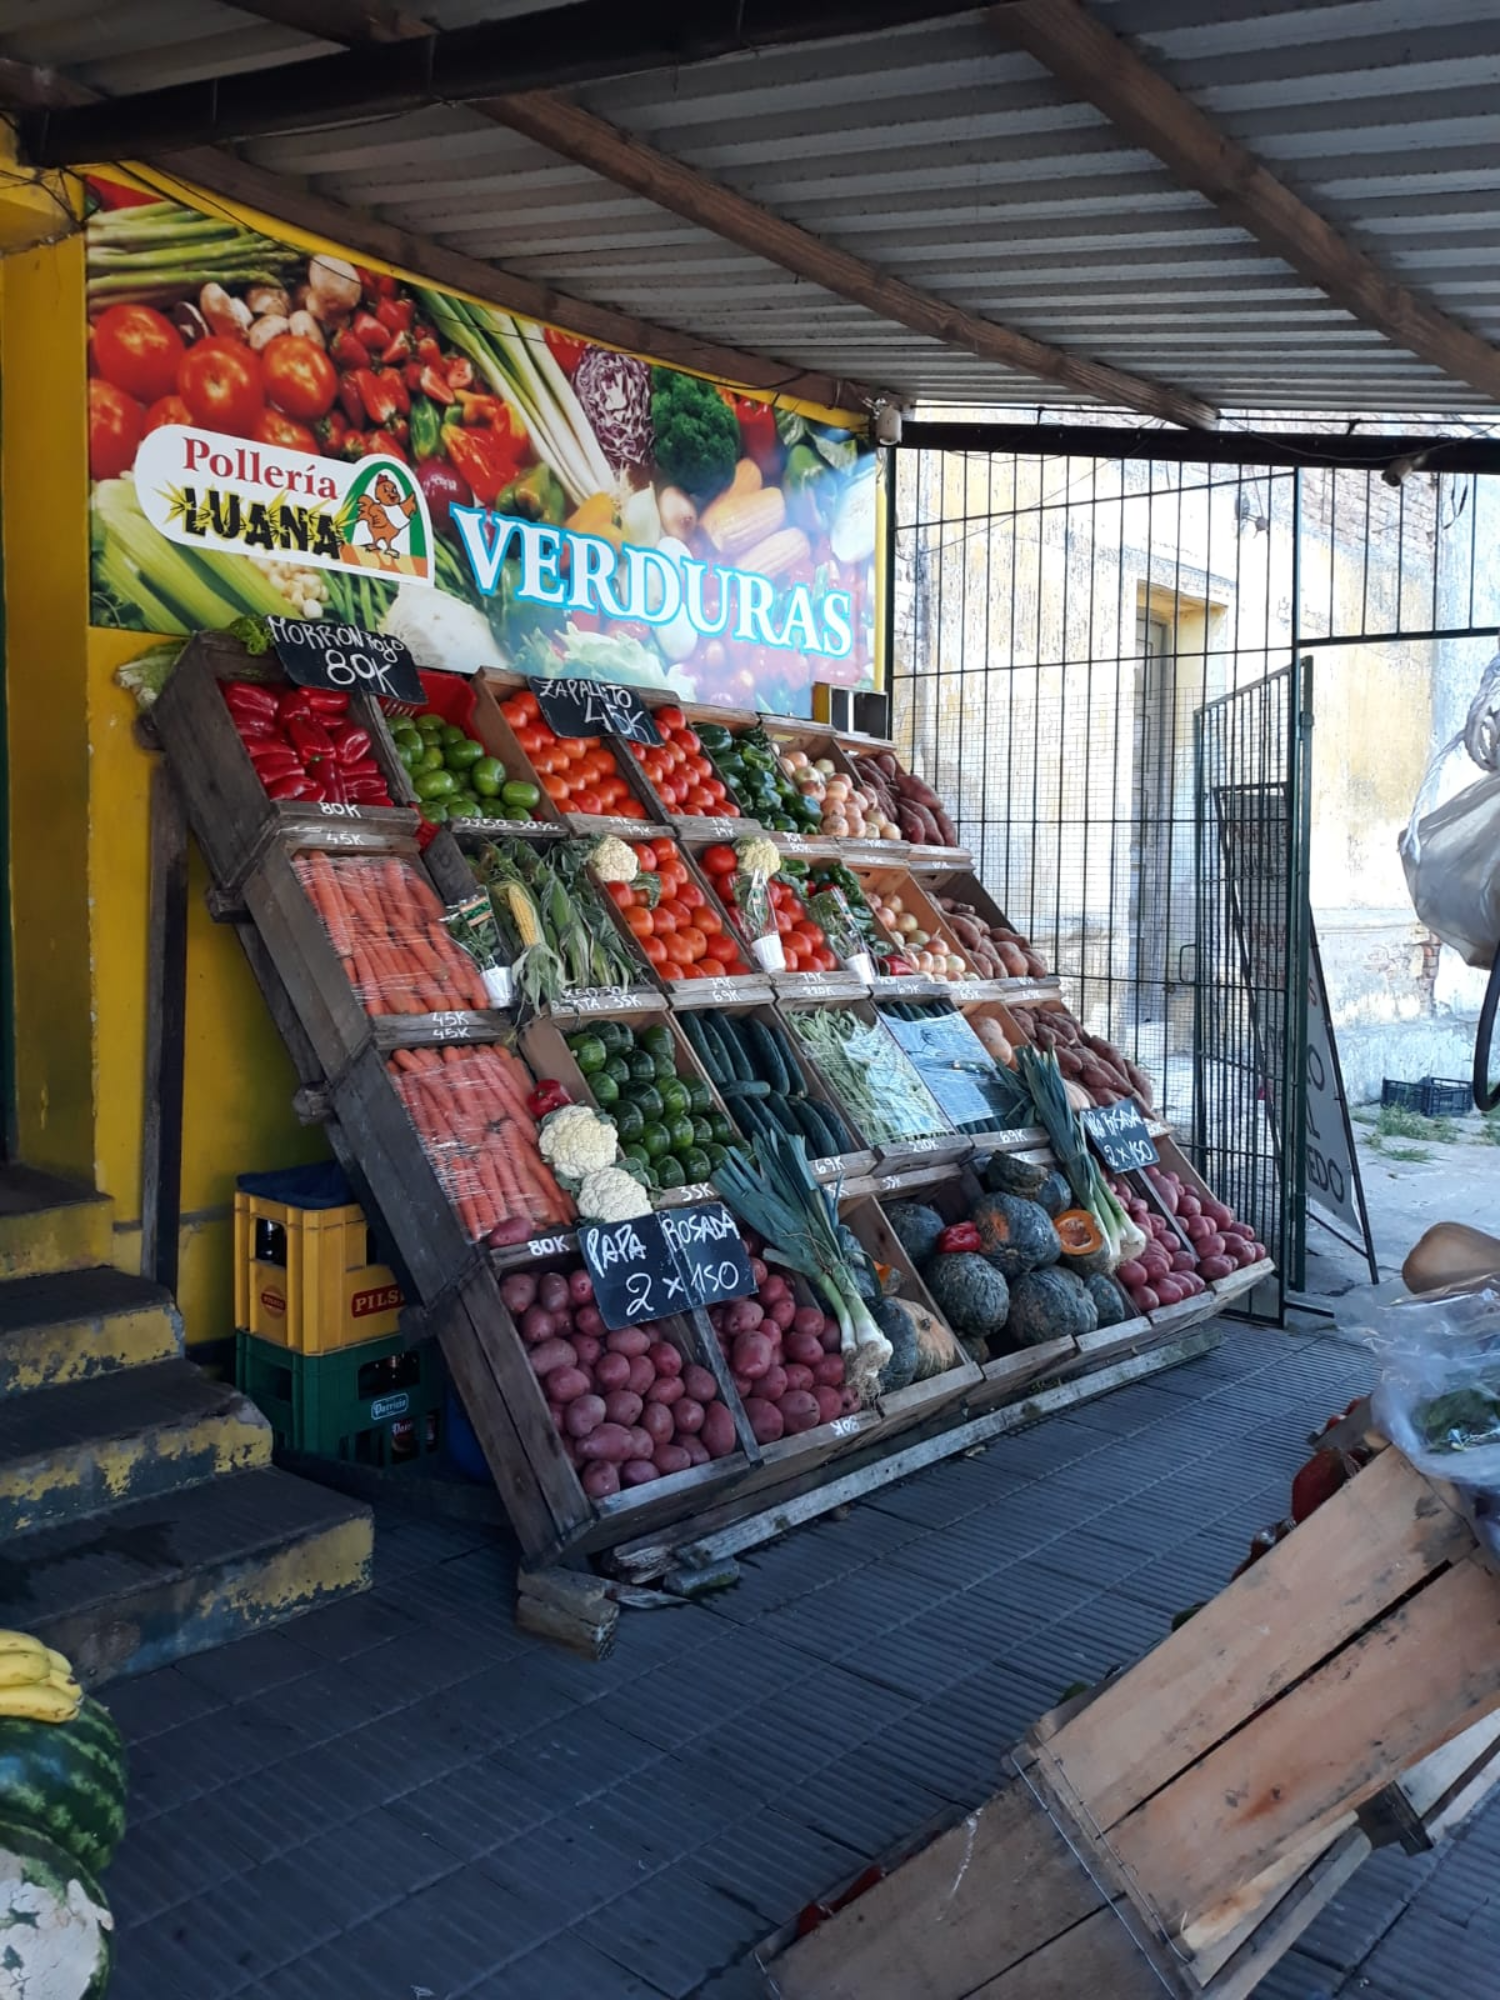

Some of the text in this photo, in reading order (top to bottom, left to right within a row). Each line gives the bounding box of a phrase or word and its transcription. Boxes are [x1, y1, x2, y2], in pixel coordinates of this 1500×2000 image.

[182, 437, 338, 500] Pollería
[182, 486, 344, 560] LUANA
[449, 502, 852, 658] VERDURAS
[325, 649, 400, 697] 80K
[319, 802, 362, 818] 80K
[326, 833, 366, 846] 45K
[712, 989, 742, 1002] 69K
[431, 1010, 470, 1027] 45K
[432, 1027, 471, 1040] 45K
[814, 1155, 847, 1175] 69K
[681, 1182, 715, 1201] 35K
[529, 1238, 570, 1256] 80K
[586, 1211, 741, 1278] PAPA ROSADA
[625, 1272, 654, 1317] 2
[691, 1260, 740, 1293] 150
[355, 1290, 404, 1312] PILS
[830, 1415, 860, 1436] 80K
